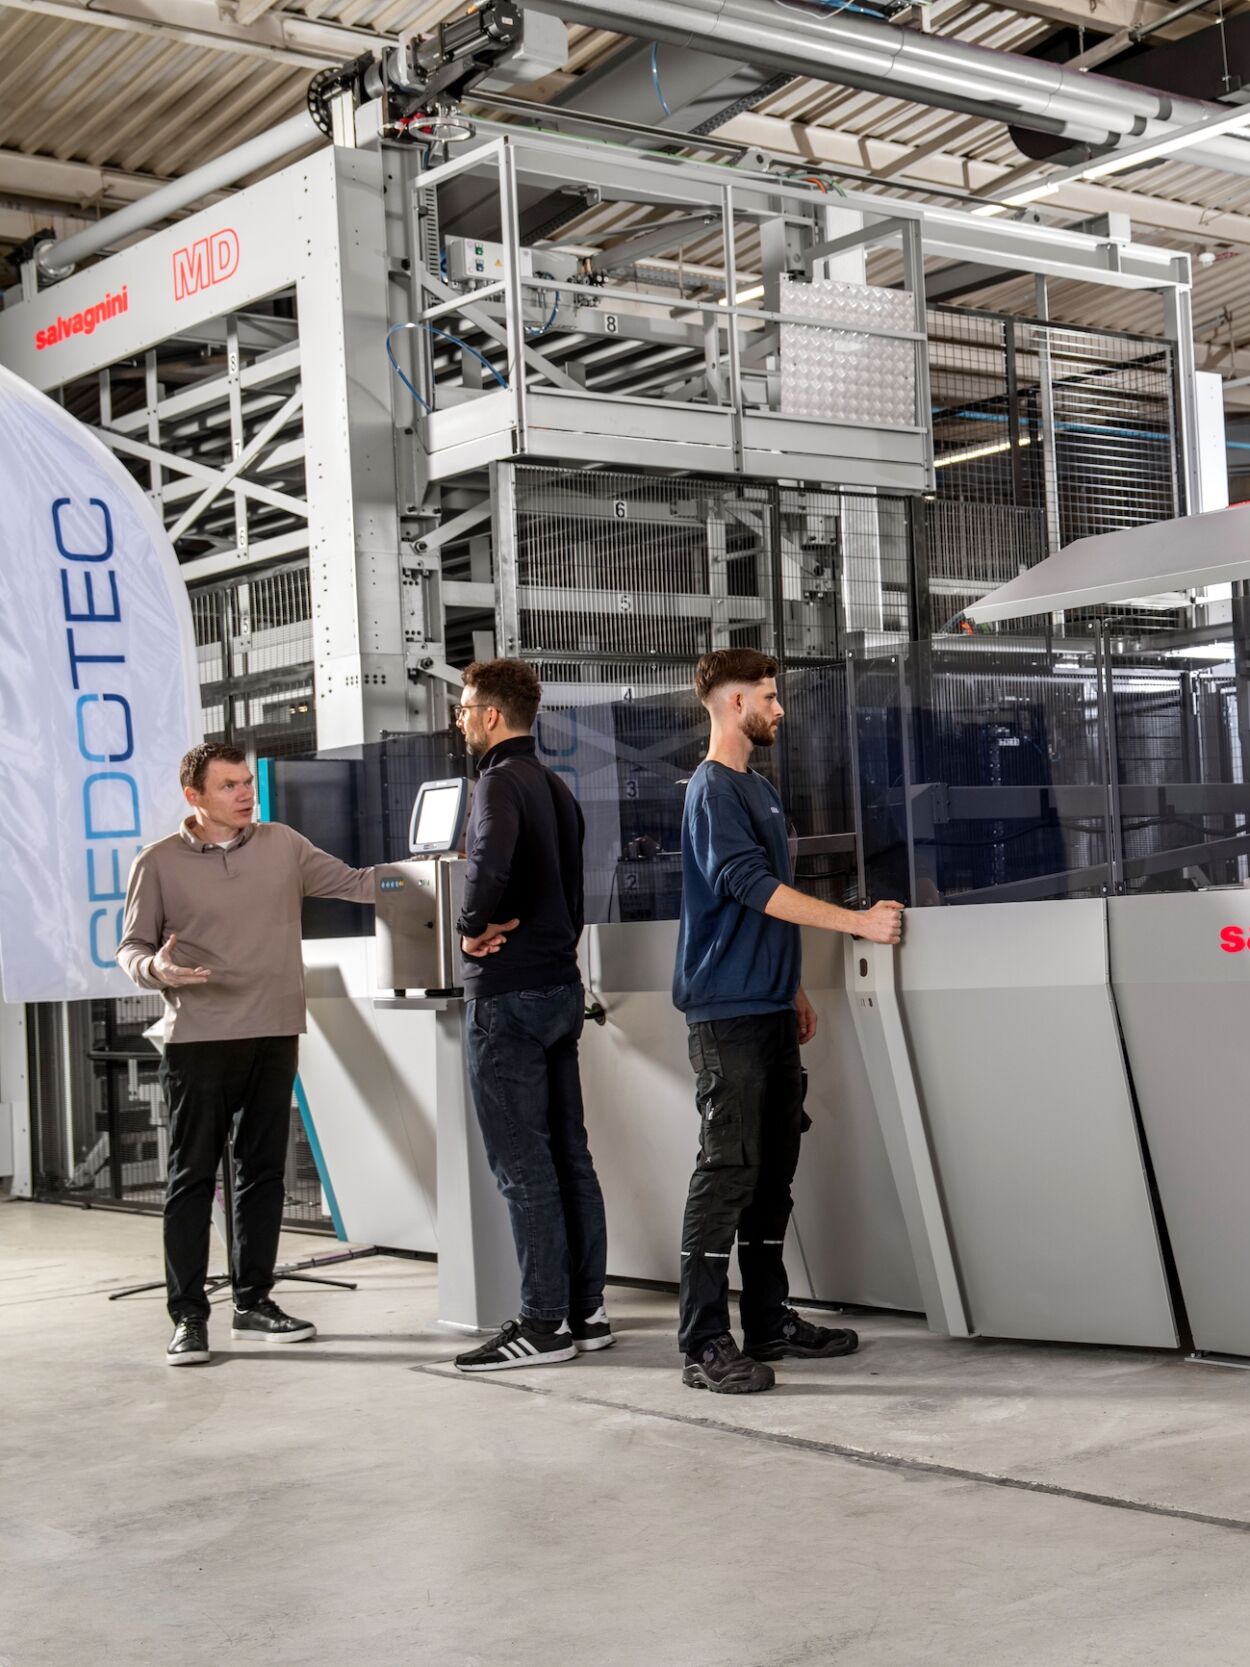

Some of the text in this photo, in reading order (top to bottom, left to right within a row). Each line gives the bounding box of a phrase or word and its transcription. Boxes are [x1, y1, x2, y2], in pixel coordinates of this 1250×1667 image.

[172, 228, 240, 301] MD
[35, 285, 129, 350] salvagnini
[606, 315, 617, 332] 8
[230, 355, 237, 372] 8
[615, 502, 625, 518] 6
[239, 529, 246, 546] 6
[621, 595, 631, 612] 5
[242, 616, 249, 634] 5
[623, 688, 633, 704] 4
[626, 780, 637, 798] 3
[626, 874, 637, 890] 2
